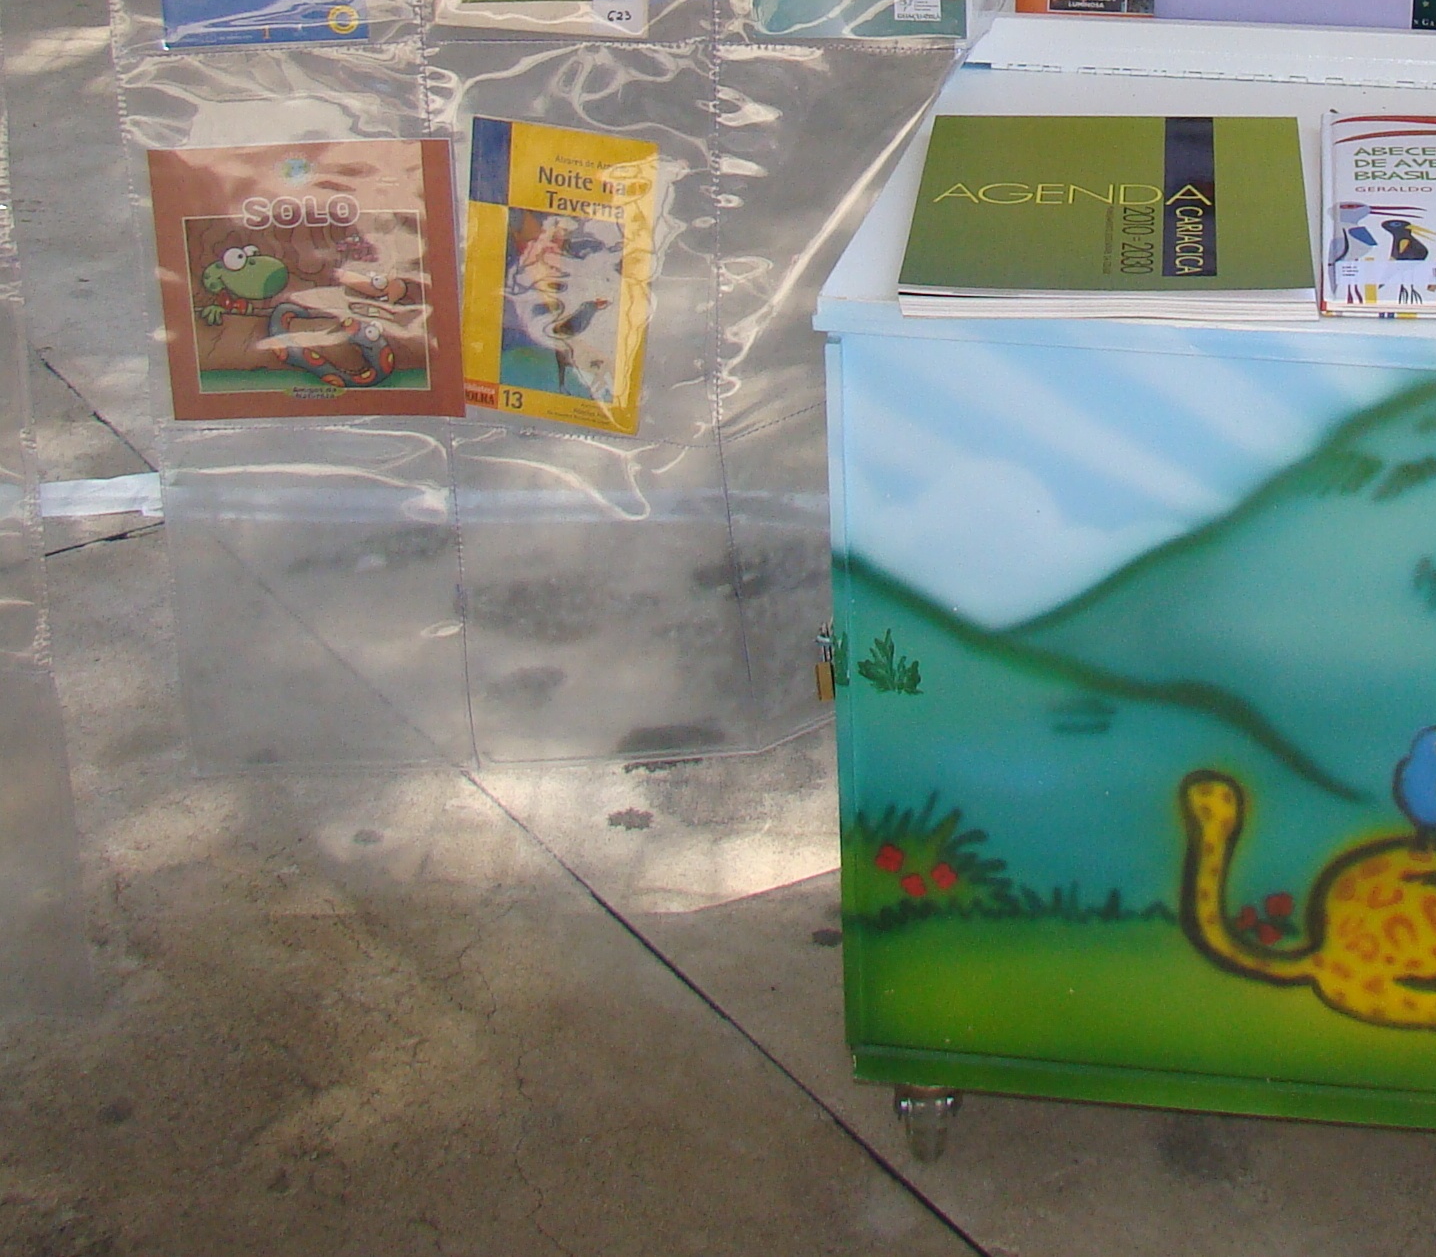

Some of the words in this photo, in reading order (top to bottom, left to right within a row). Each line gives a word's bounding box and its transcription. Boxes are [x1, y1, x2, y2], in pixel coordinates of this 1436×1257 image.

[1354, 158, 1387, 168] DE
[538, 165, 593, 191] Noite
[602, 180, 626, 196] na
[933, 182, 1213, 206] AGENDA
[243, 194, 360, 230] SOLO
[545, 190, 624, 219] Taverna
[1175, 206, 1204, 275] CARIACICA
[503, 389, 523, 409] 13
